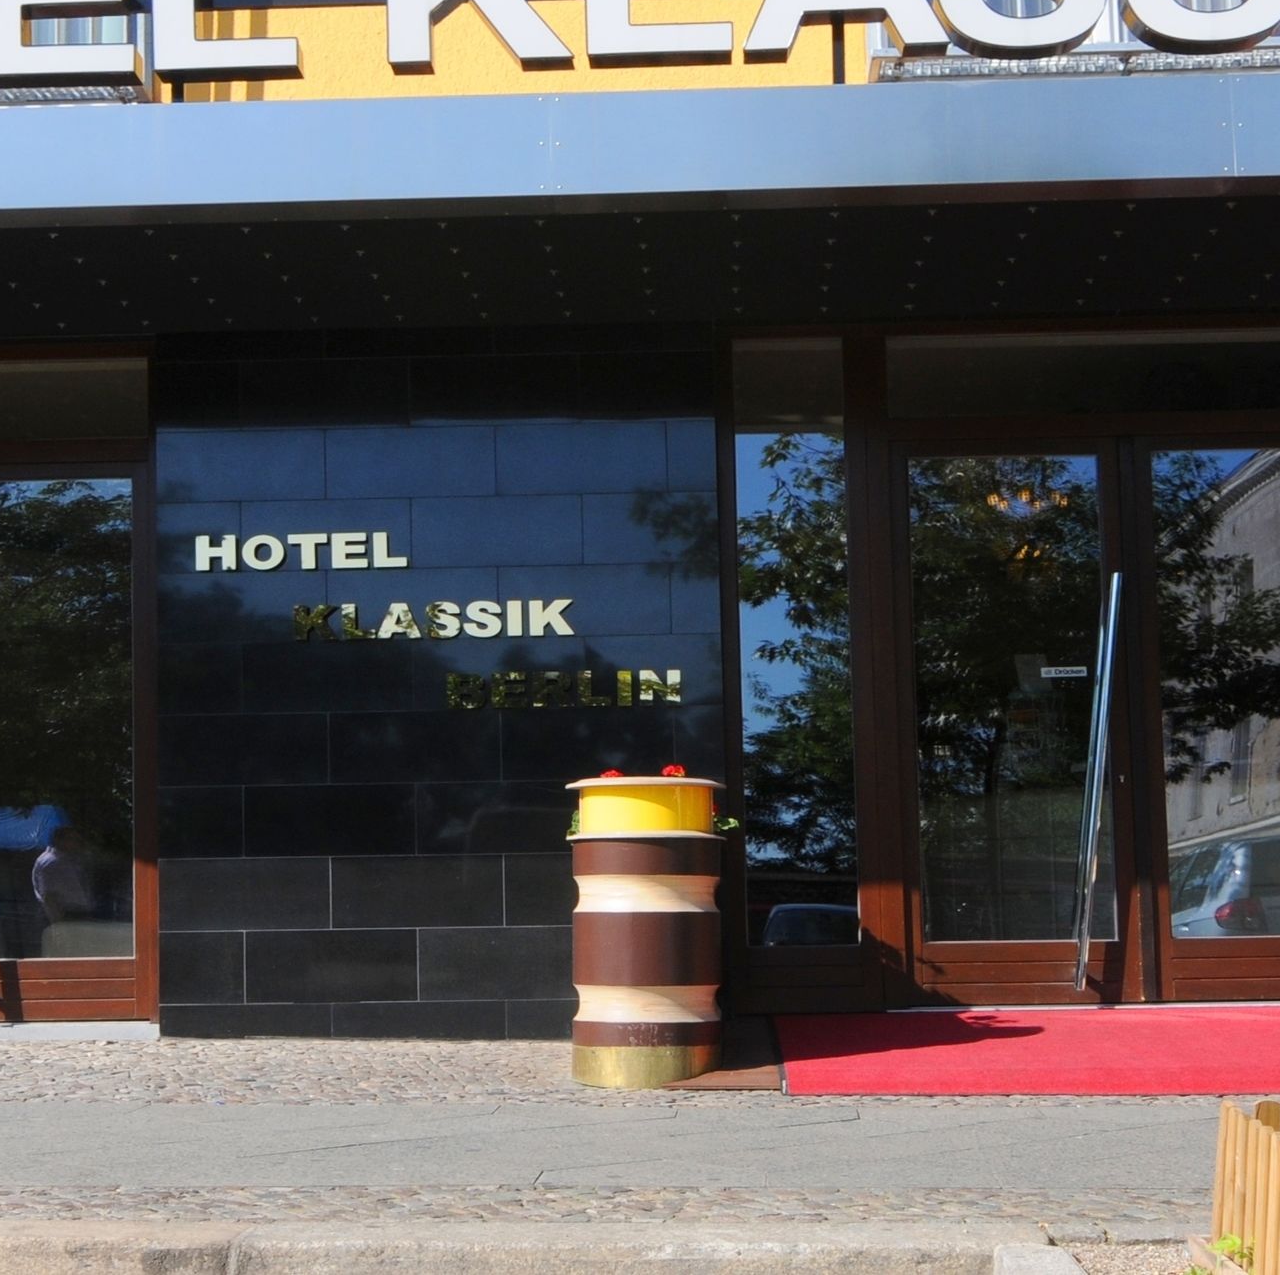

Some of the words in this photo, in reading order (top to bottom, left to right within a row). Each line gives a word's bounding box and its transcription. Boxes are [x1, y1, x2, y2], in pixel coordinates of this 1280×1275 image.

[194, 532, 409, 572] HOTEL
[291, 598, 575, 640] KLASSIK
[446, 669, 682, 710] BERLIN
